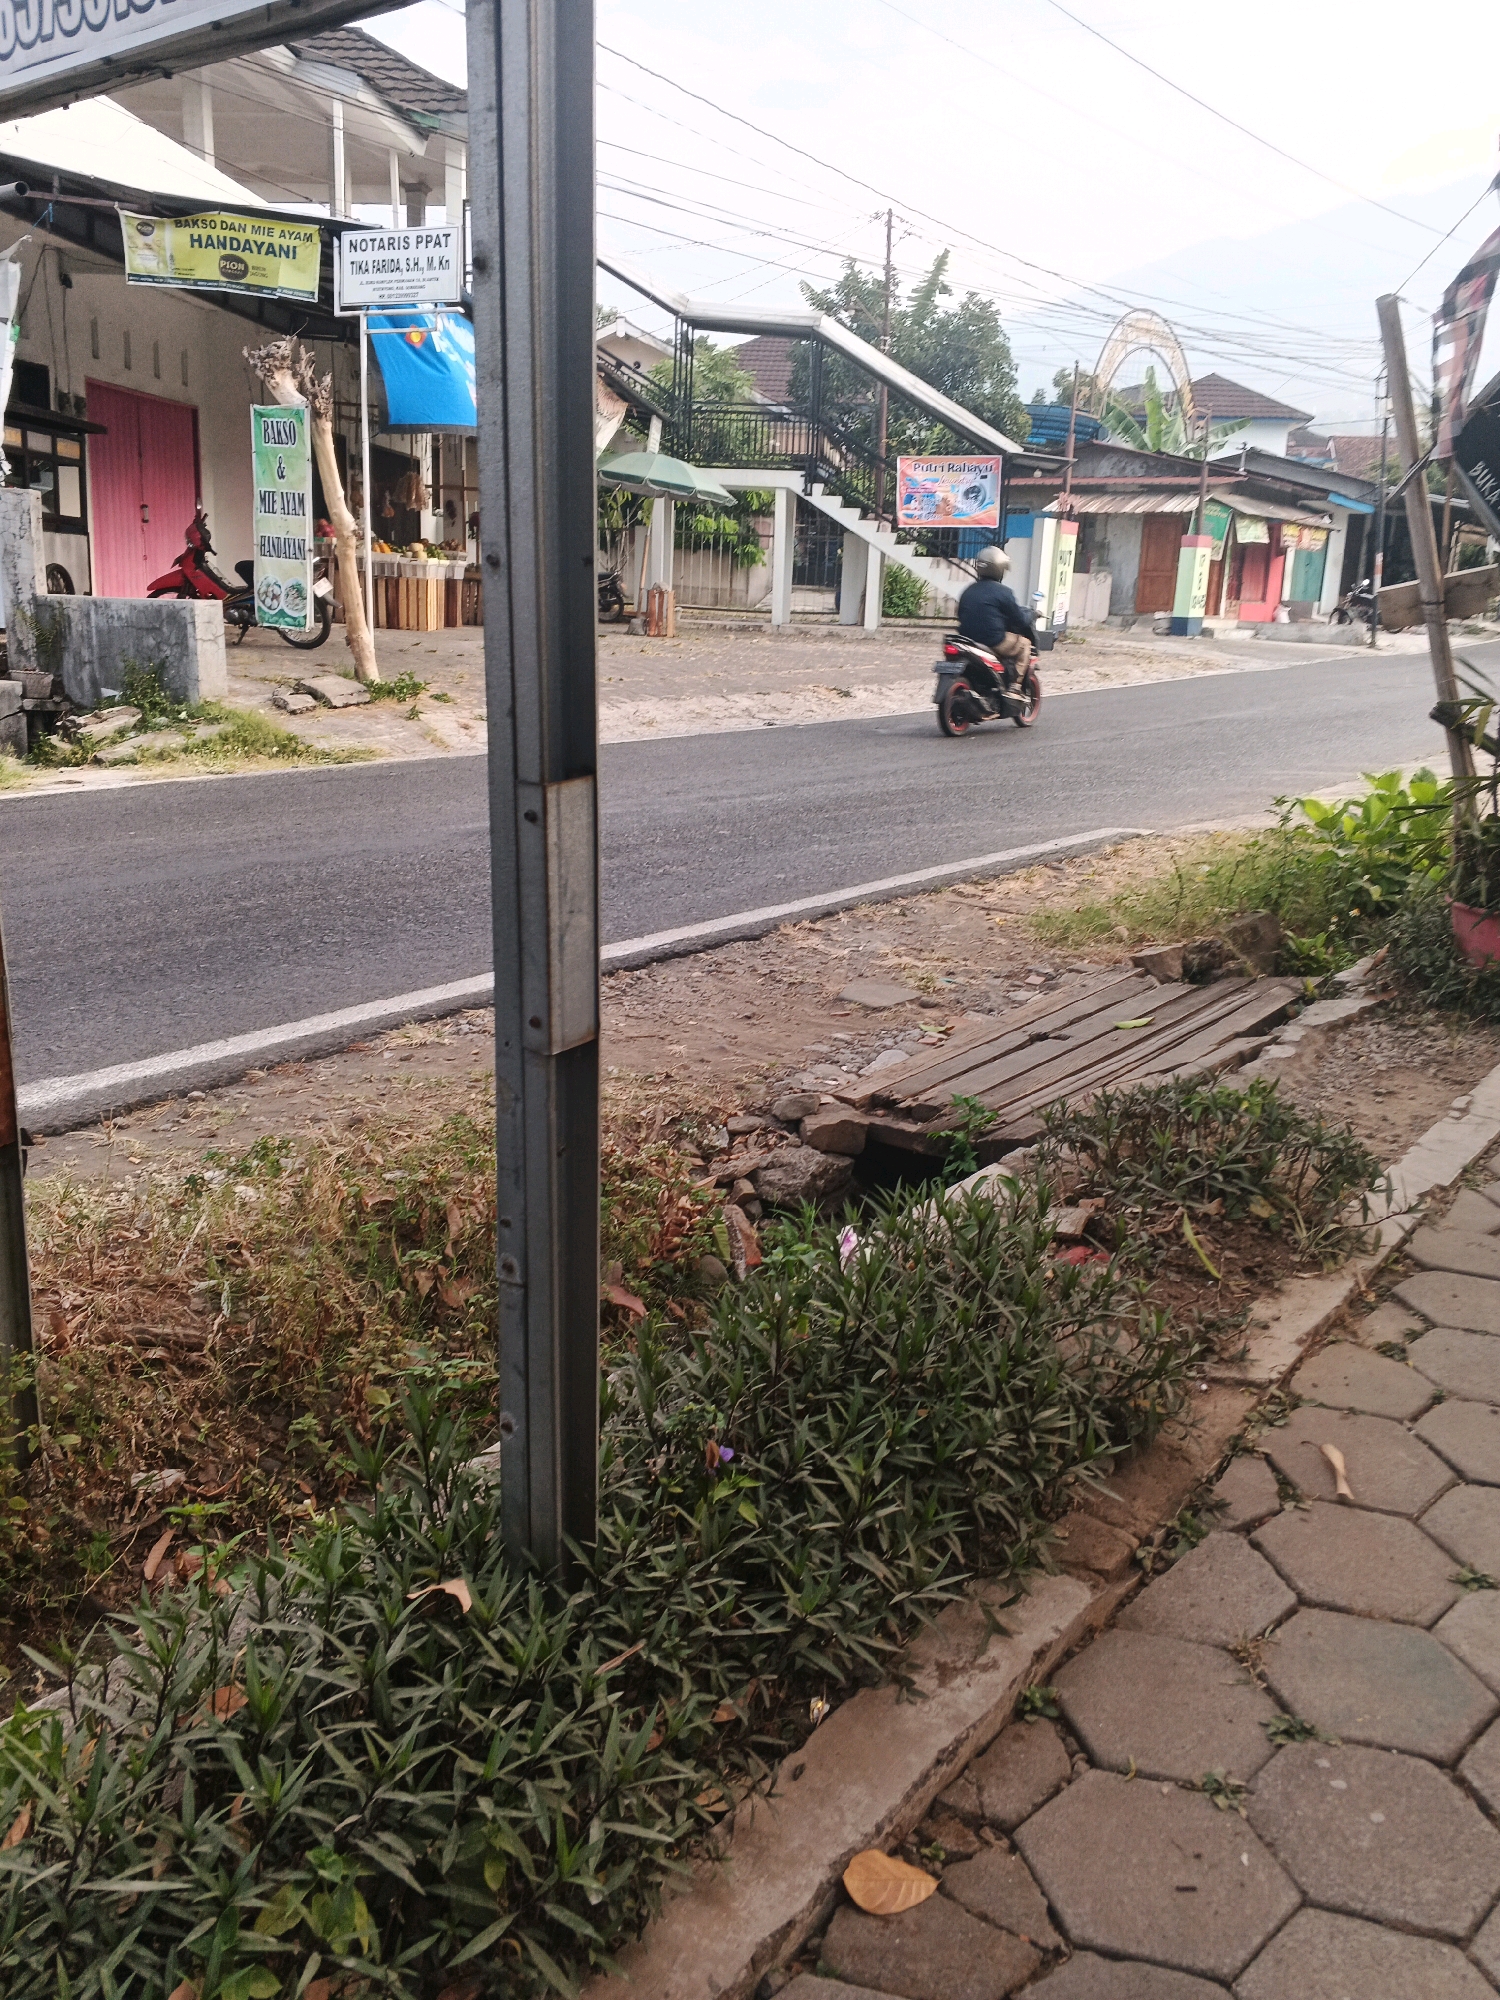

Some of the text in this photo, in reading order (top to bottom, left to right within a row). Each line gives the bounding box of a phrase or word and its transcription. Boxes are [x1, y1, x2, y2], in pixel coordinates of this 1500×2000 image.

[174, 218, 313, 243] BAKSO DAN MIE AYAM
[349, 233, 451, 253] NOTARIS PPAT
[190, 233, 297, 260] HANDAYANI
[220, 260, 245, 271] PION
[350, 260, 370, 275] TIKA
[372, 258, 403, 276] FARIDA,
[262, 419, 297, 446] BAKSO
[276, 455, 286, 480] &
[913, 462, 994, 475] Putri Rahayu
[1468, 460, 1500, 505] BUKA
[259, 489, 306, 517] MIE AYAM
[260, 535, 307, 561] HANDAYANI
